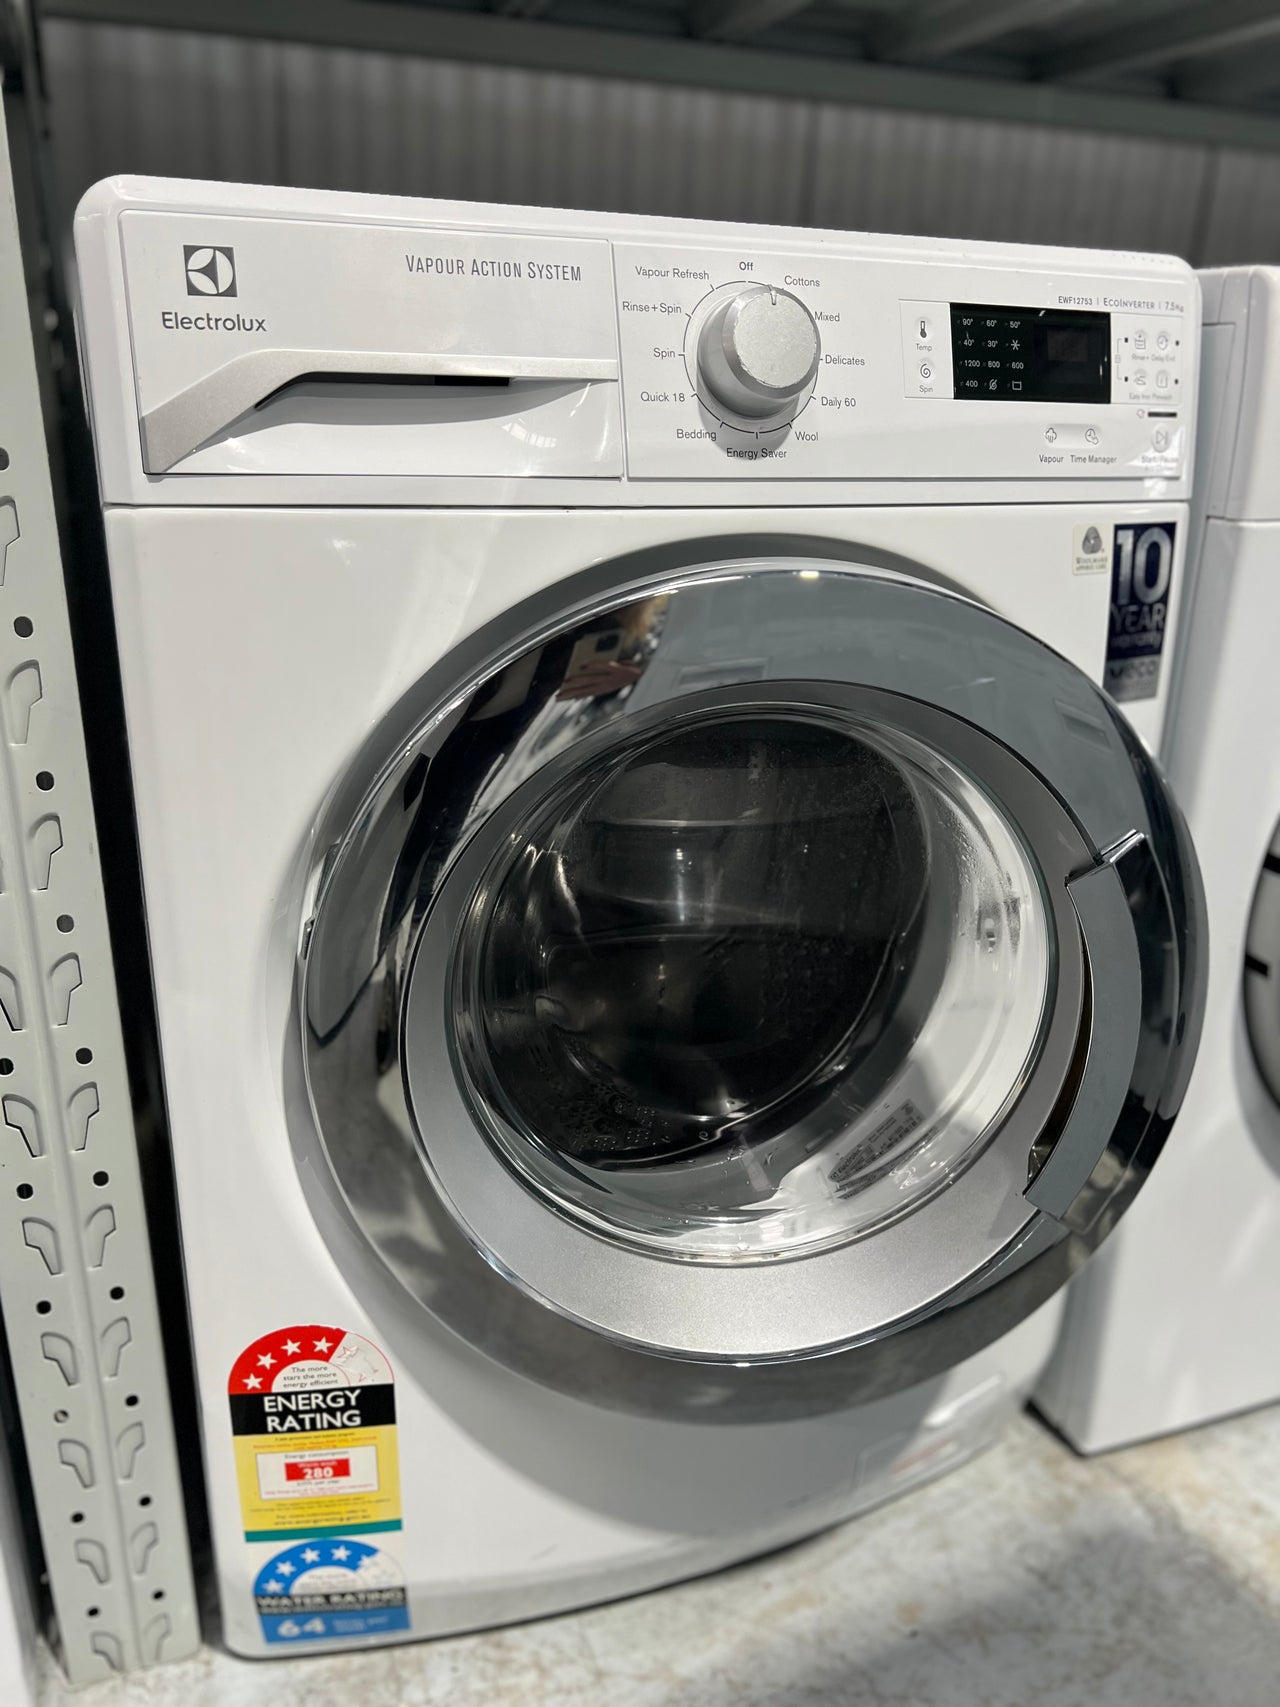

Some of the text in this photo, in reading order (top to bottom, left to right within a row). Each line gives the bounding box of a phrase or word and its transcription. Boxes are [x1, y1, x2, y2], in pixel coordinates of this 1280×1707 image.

[739, 261, 754, 271] Off
[635, 265, 710, 280] Vapour Refresh
[784, 275, 821, 287] Cottons
[1058, 296, 1093, 306] EWF12753
[161, 311, 267, 332] Electrolux
[814, 311, 840, 322] Mixed
[916, 343, 932, 352] Temp
[653, 348, 676, 359] Spin
[825, 355, 865, 366] Delicates
[964, 360, 981, 368] 1200
[1011, 362, 1024, 370] 600
[919, 385, 934, 394] Spin
[965, 380, 979, 388] 400
[640, 391, 685, 403] Quick 18
[821, 397, 856, 410] Daily 60
[676, 429, 717, 442] Bedding
[795, 431, 819, 442] Wool
[726, 448, 787, 460] Energy Saver
[1039, 454, 1064, 464] Vapour
[1070, 454, 1117, 465] Time Manager
[1116, 526, 1172, 606] 10
[1110, 602, 1166, 633] YEAR
[263, 1388, 361, 1413] ENERGY
[266, 1410, 361, 1433] RATING
[303, 1467, 333, 1479] 280
[277, 1616, 326, 1638] 64
